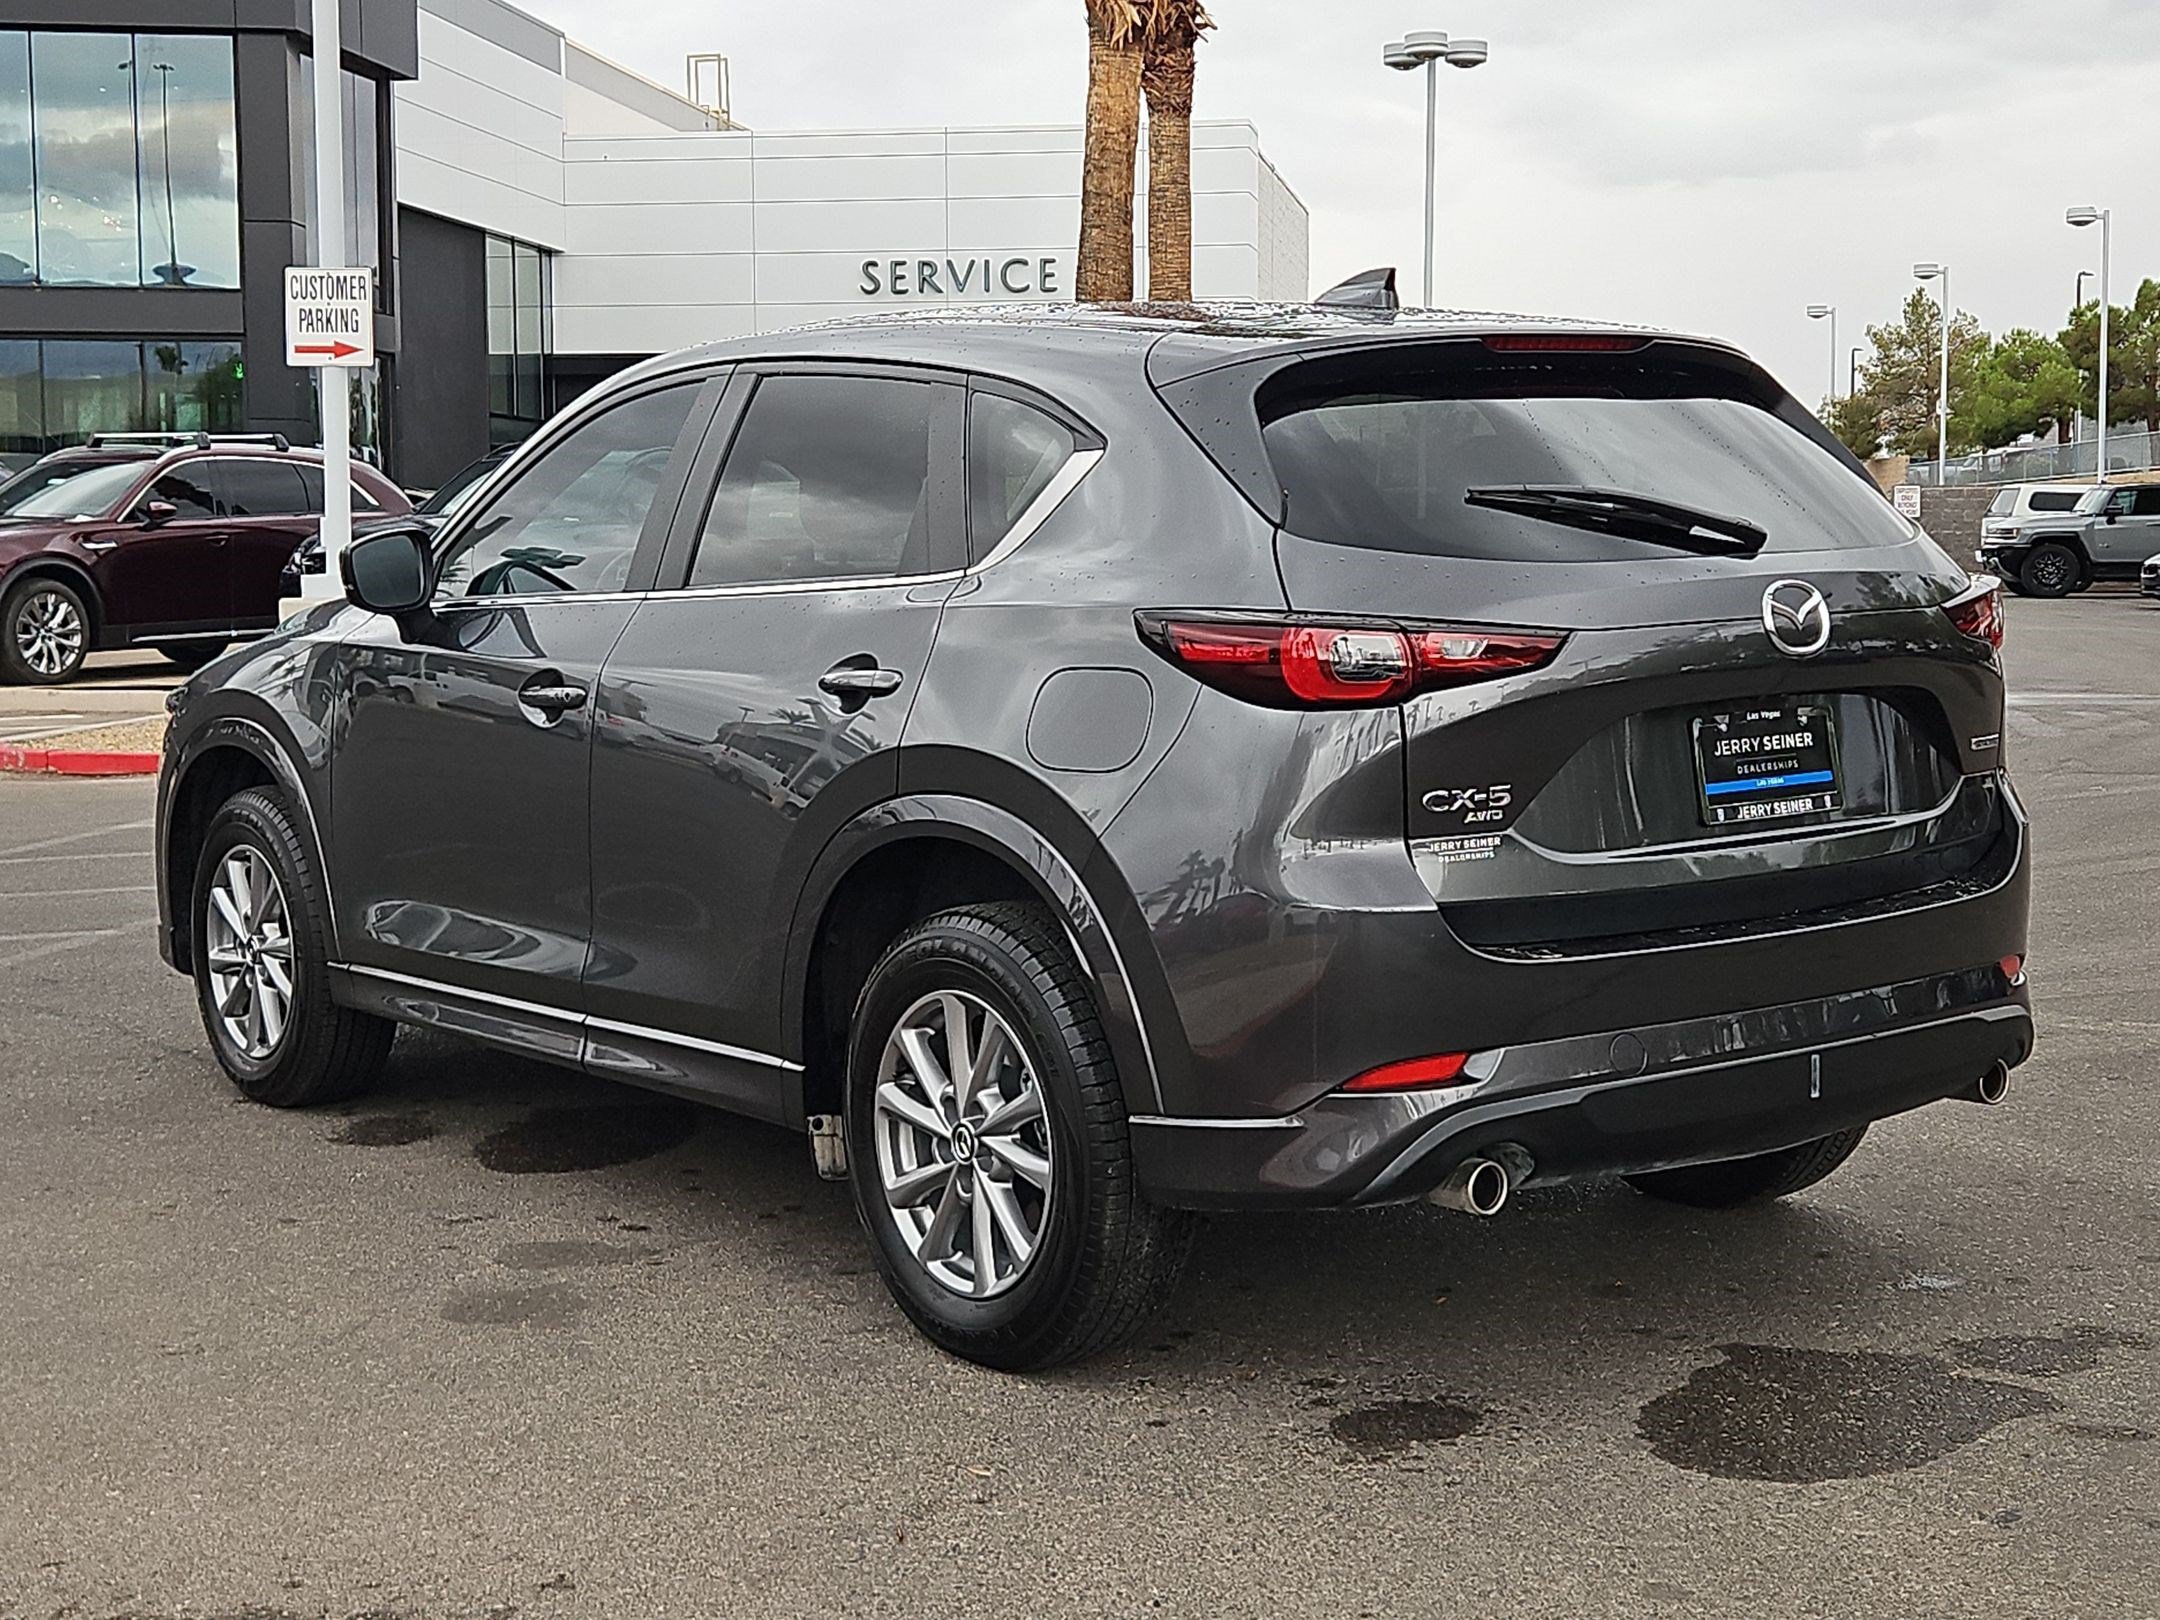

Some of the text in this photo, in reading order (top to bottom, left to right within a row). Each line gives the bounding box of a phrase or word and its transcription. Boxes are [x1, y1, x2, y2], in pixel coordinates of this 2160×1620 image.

[290, 274, 367, 300] CUSTOMER
[860, 258, 1058, 295] SERVICE
[299, 307, 359, 333] PARKING
[1714, 732, 1814, 757] JERRY SEINER
[1737, 760, 1799, 775] DEALERSHIPS
[1422, 784, 1512, 812] CX-5
[1737, 798, 1814, 820] JERRY SEINER
[1463, 809, 1504, 824] AWD
[1429, 837, 1501, 852] JERRY SEINER
